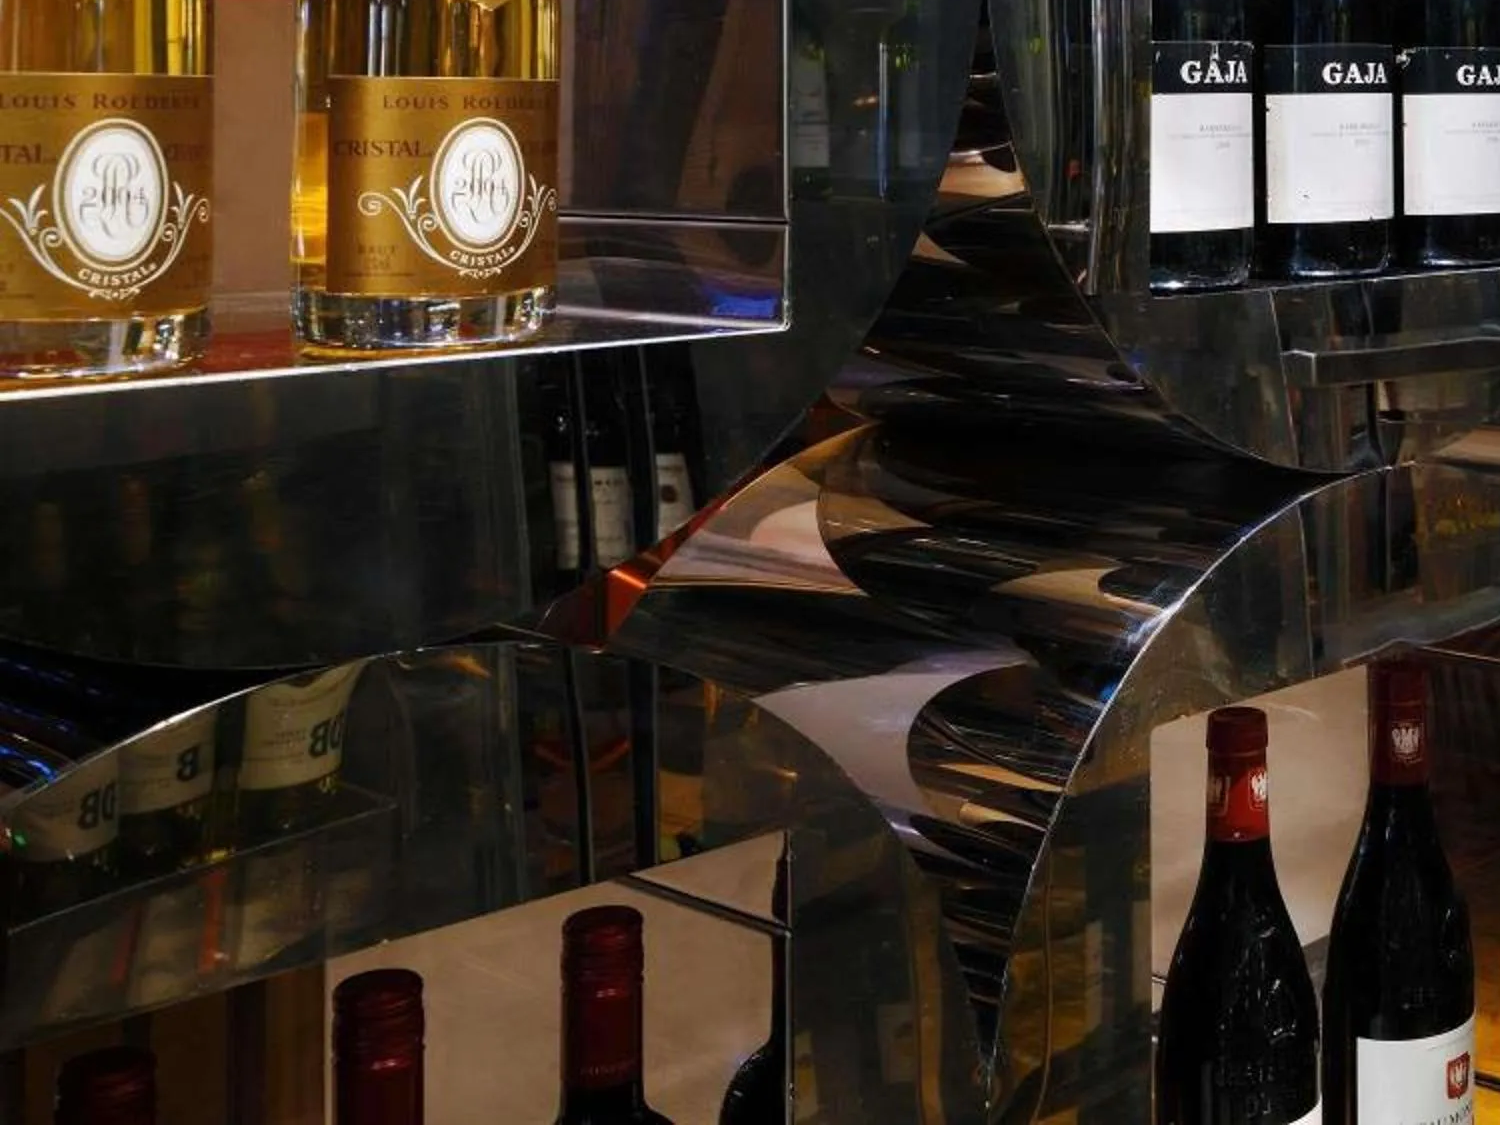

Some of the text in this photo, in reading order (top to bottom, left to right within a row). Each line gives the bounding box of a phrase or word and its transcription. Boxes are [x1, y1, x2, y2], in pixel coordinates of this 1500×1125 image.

[1180, 60, 1248, 84] GAJA
[1321, 62, 1388, 85] GAJA
[383, 94, 450, 111] LOUIS
[334, 139, 427, 157] CRISTAL
[450, 246, 510, 267] CRISTAL
[78, 265, 150, 287] CRISTAL
